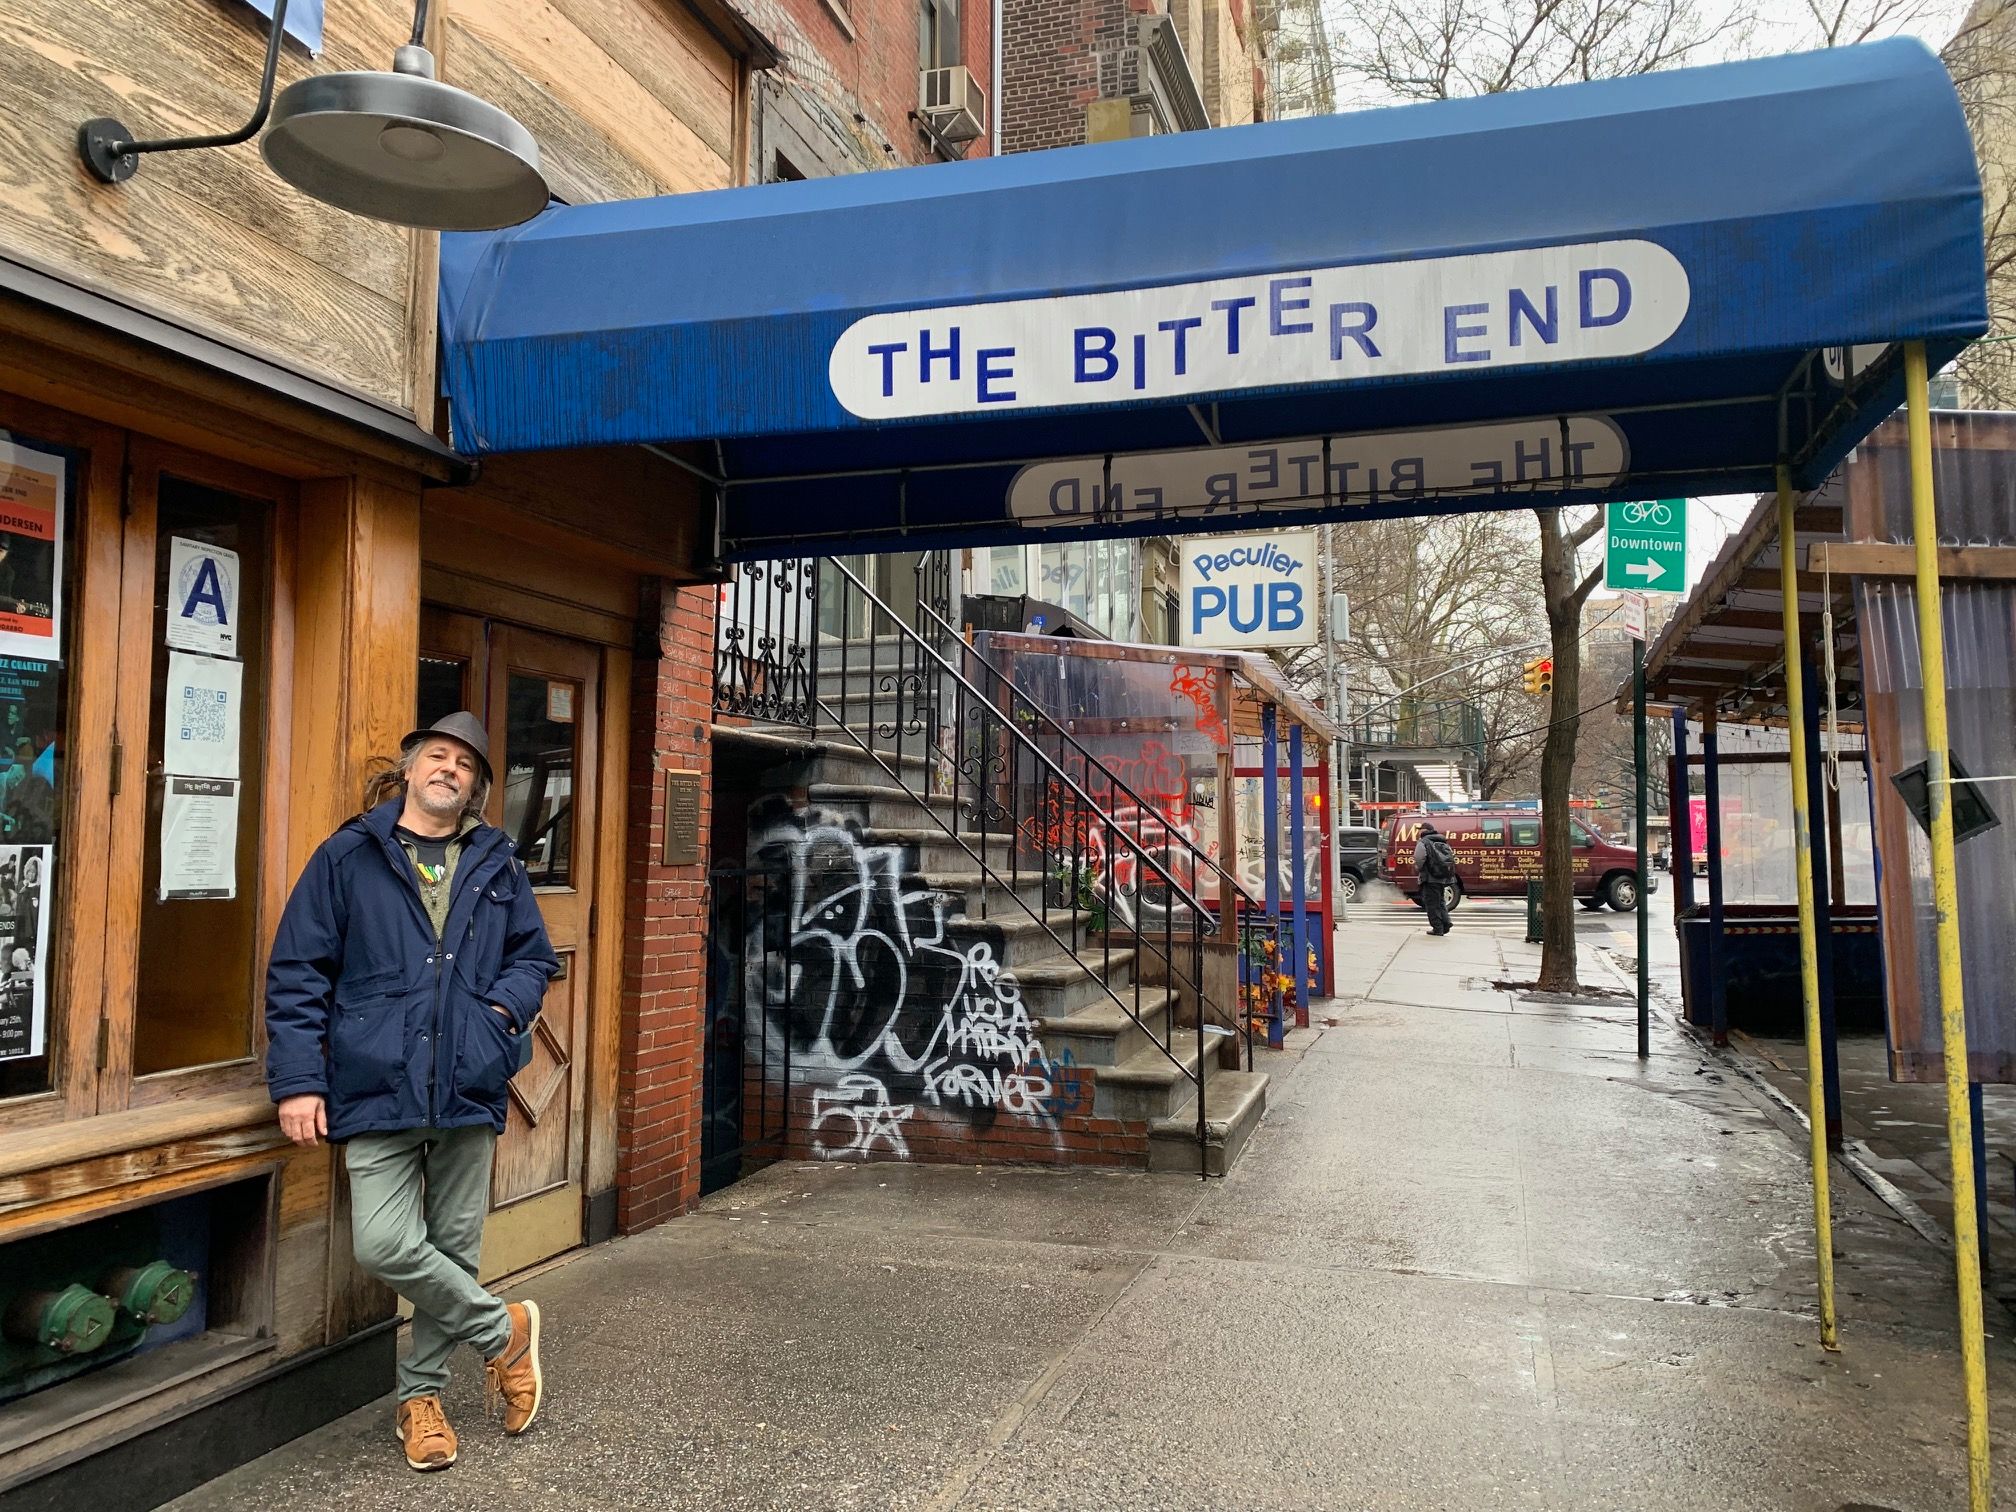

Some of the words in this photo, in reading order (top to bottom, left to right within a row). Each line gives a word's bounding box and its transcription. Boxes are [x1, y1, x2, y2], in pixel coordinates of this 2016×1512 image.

[867, 326, 1017, 403] THE
[1073, 276, 1383, 390] BITTER
[1444, 268, 1632, 364] END
[1611, 535, 1682, 552] Downtown
[1193, 542, 1304, 582] Peculier
[181, 557, 228, 626] A
[1192, 581, 1304, 635] PUB
[220, 633, 232, 641] NYC
[184, 782, 194, 791] THE
[194, 782, 211, 791] BITTER
[212, 784, 221, 792] END
[1460, 831, 1502, 842] penna
[1497, 848, 1541, 857] Hating
[1396, 856, 1415, 865] 516
